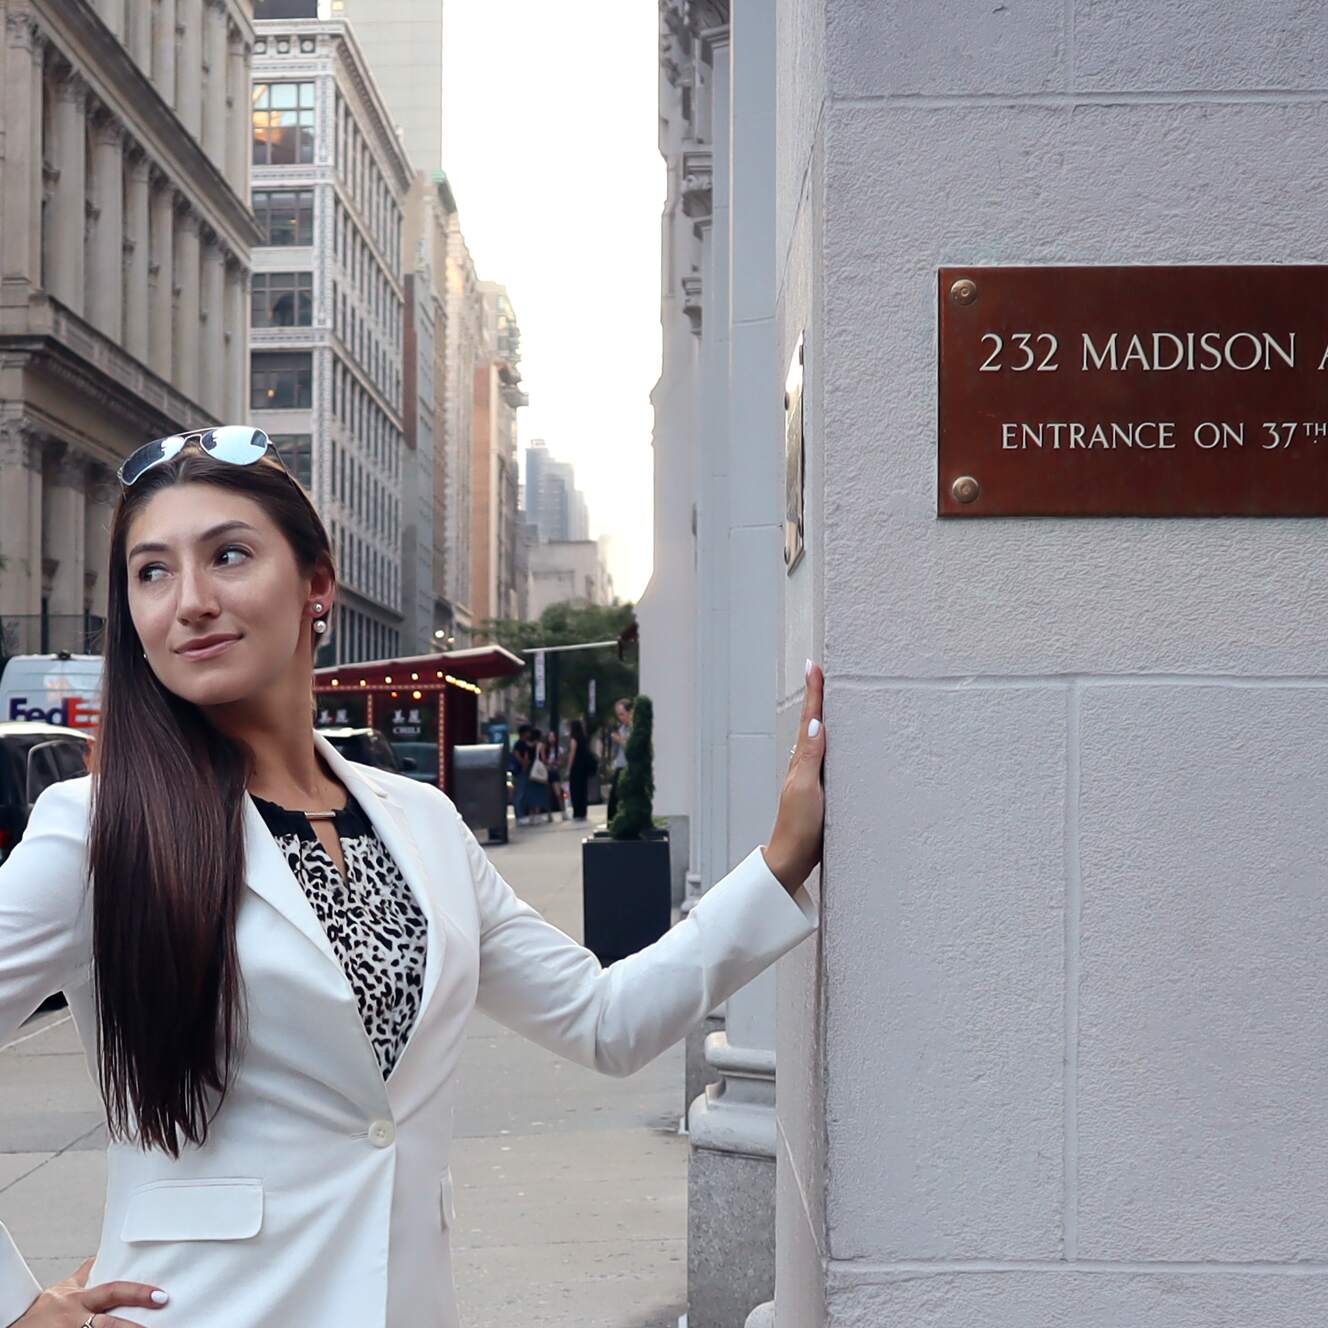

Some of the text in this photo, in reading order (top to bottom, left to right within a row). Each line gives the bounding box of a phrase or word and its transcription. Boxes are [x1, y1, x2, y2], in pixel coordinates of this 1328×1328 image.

[979, 333, 1059, 372] 232
[1081, 332, 1296, 371] MADISON
[1002, 422, 1176, 449] ENTRANCE
[1194, 422, 1244, 449] ON
[1262, 422, 1327, 449] 37TH
